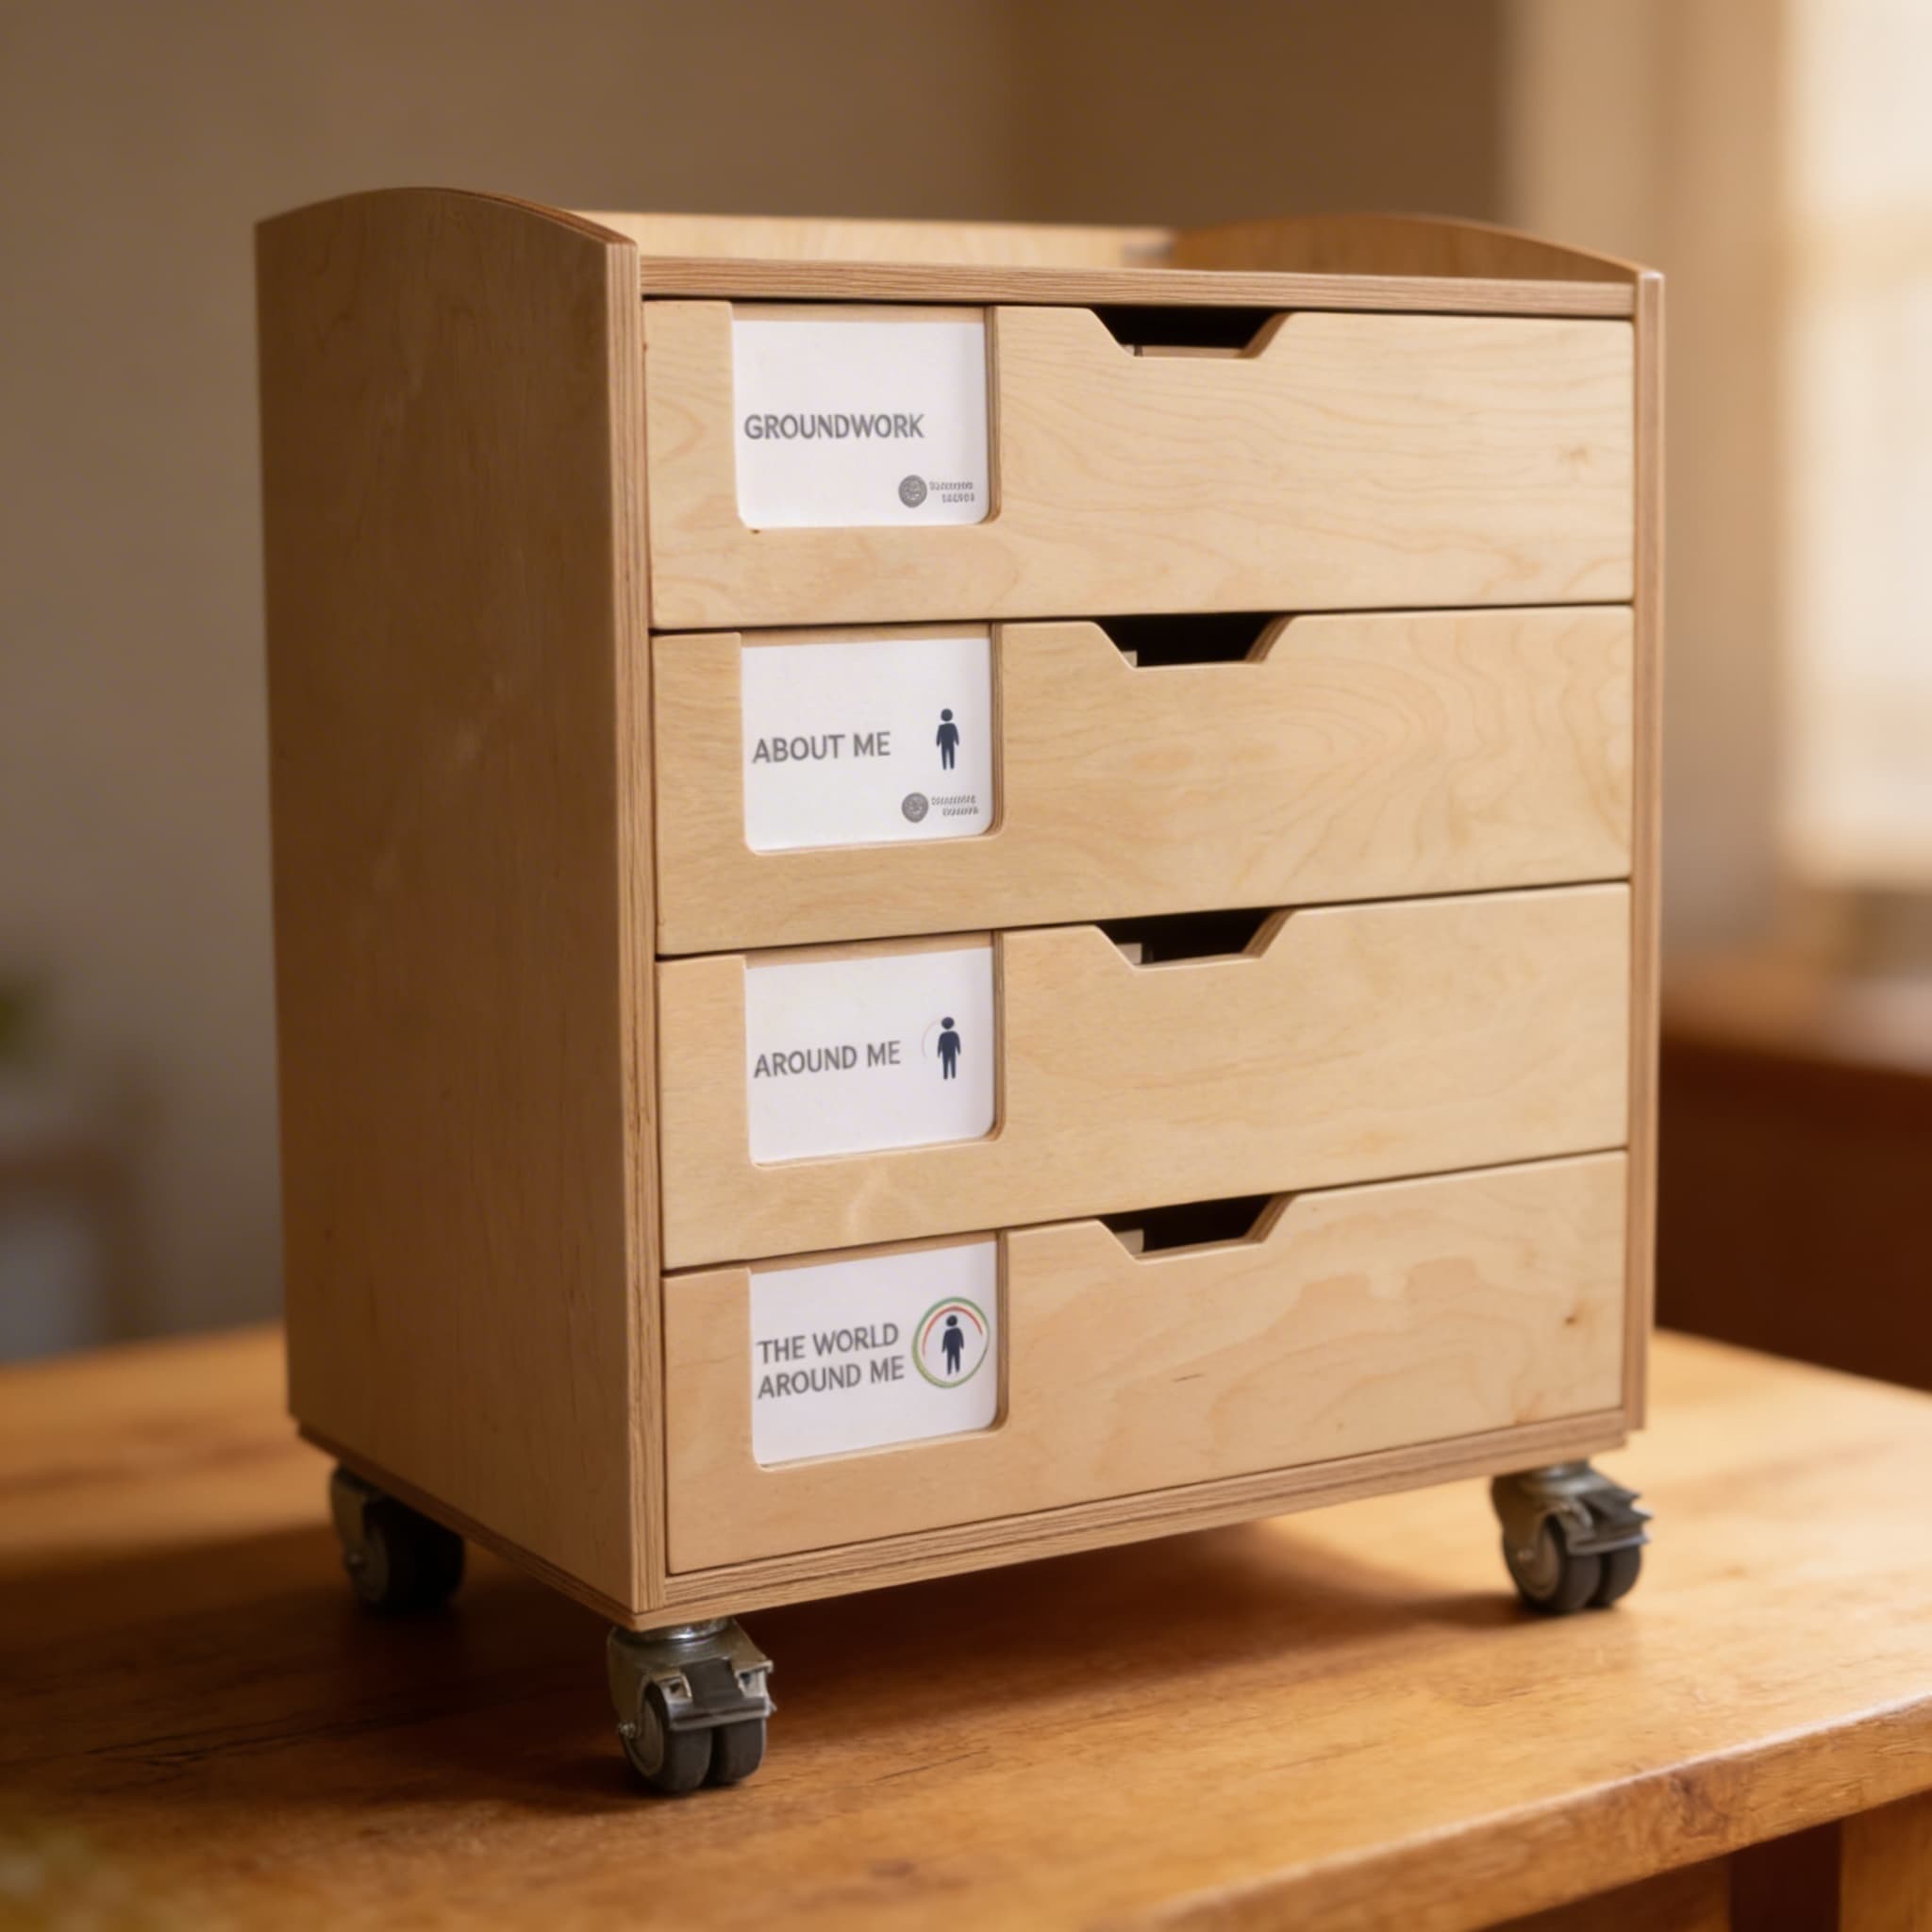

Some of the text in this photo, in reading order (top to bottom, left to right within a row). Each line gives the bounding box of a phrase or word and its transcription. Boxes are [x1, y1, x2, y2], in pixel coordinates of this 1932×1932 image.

[744, 414, 924, 440] GROUNDWORK
[753, 732, 891, 763] ABOUT ME
[754, 1041, 901, 1078] AROUND ME
[758, 1323, 899, 1364] THE WORLD
[758, 1356, 906, 1399] AROUND ME
